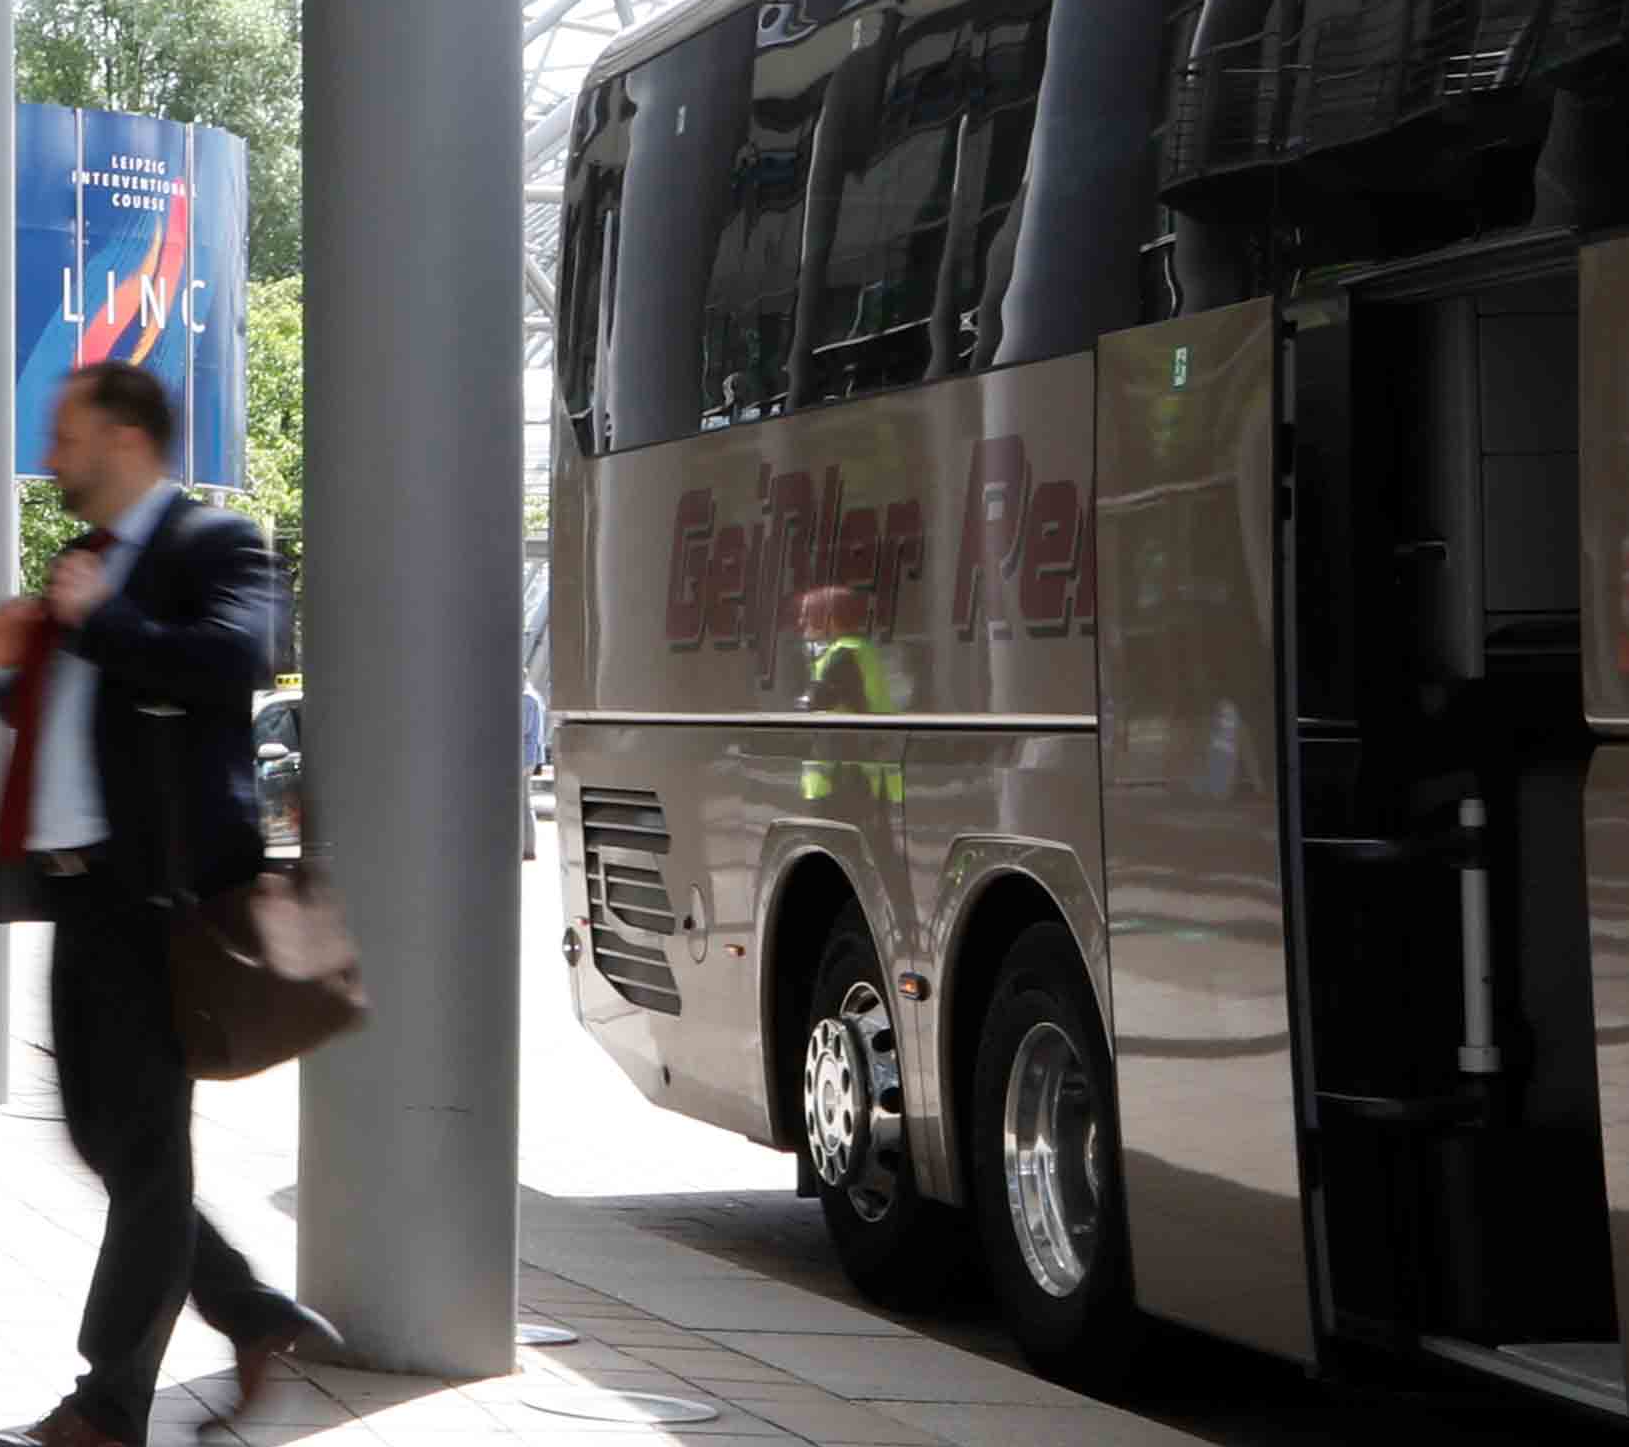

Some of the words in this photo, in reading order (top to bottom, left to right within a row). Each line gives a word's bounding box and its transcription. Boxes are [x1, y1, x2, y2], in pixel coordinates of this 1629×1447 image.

[111, 154, 167, 176] LEIPZIG
[111, 192, 166, 213] COURSE
[63, 267, 207, 334] LINC
